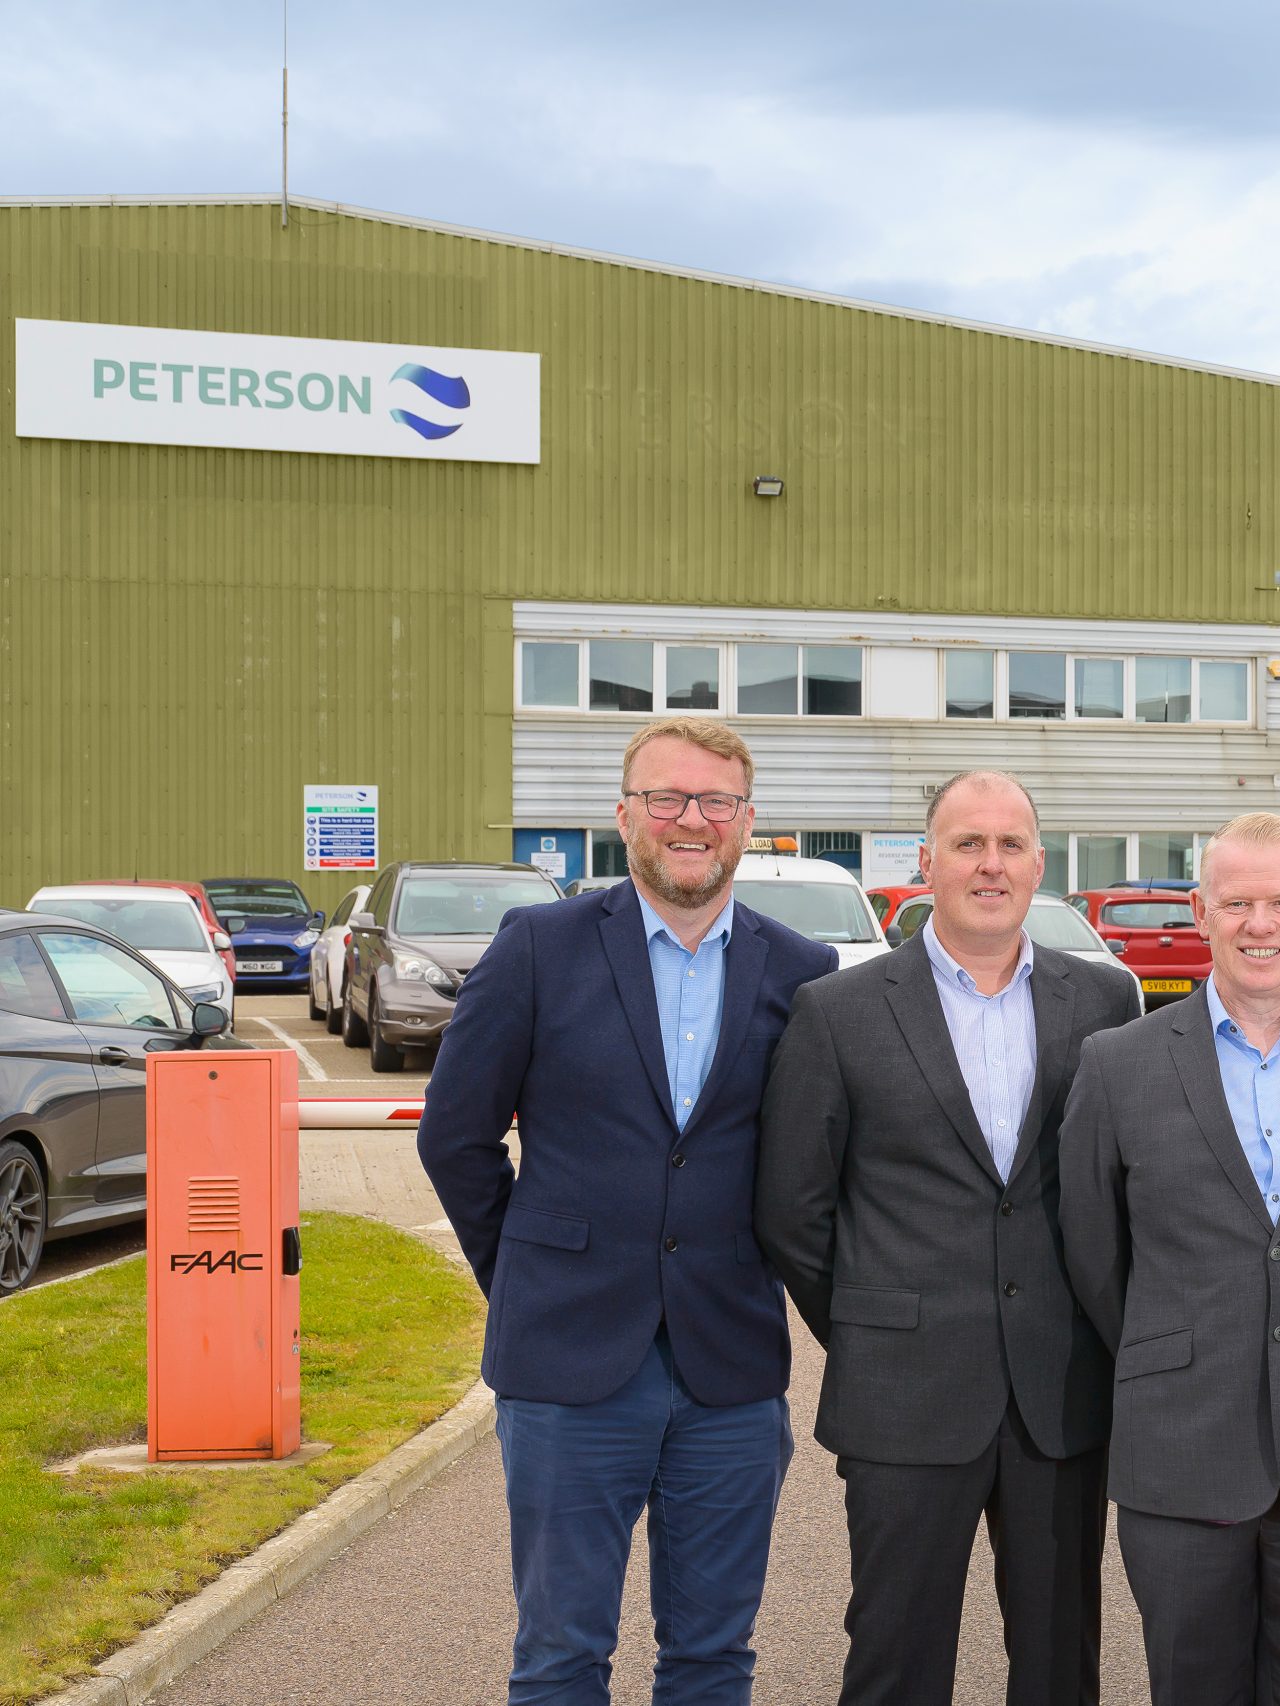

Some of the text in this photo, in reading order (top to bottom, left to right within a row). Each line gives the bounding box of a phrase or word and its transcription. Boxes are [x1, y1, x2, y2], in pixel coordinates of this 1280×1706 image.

[93, 358, 372, 415] PETERSON
[755, 839, 772, 848] LOAD
[874, 839, 915, 847] PETERSON
[1147, 981, 1186, 990] SV18 KYT
[170, 1250, 263, 1275] FAAC
